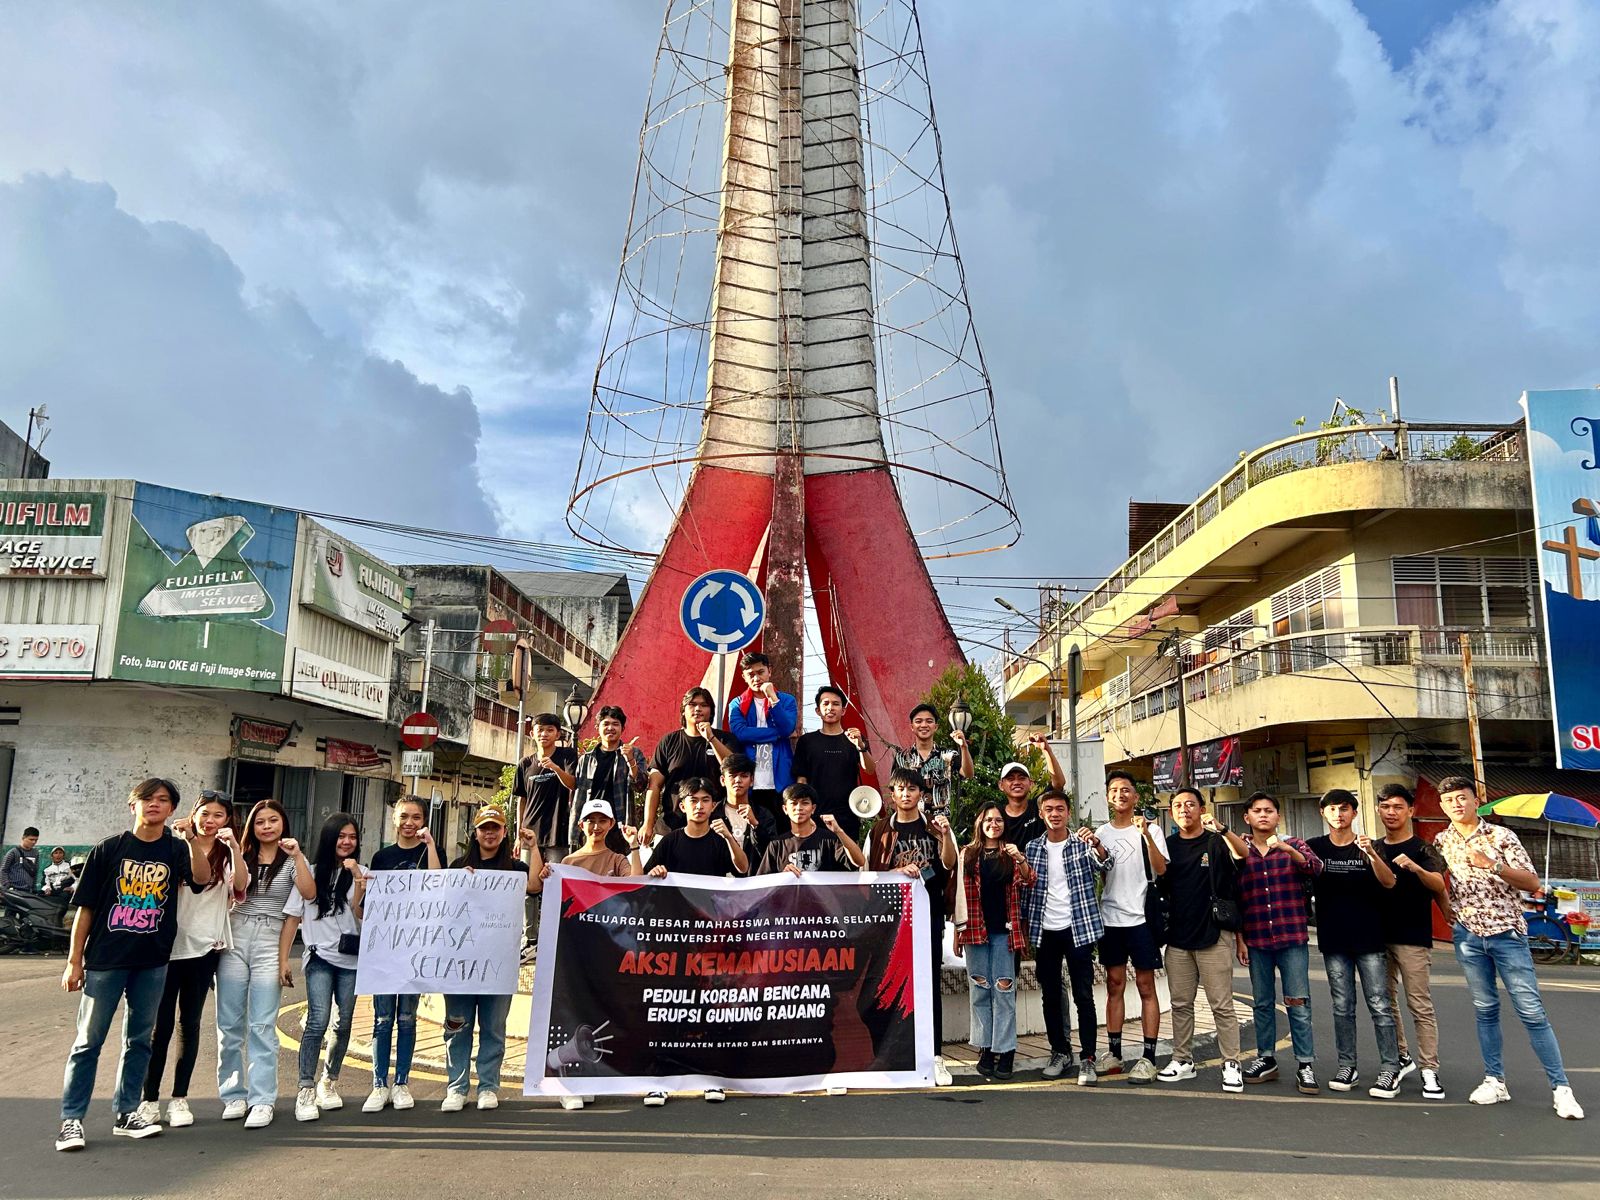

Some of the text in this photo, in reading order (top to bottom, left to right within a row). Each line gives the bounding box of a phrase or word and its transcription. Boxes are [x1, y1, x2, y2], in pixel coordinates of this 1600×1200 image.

[9, 554, 96, 570] SERVICE
[165, 570, 244, 588] FUJIFILM
[358, 563, 404, 604] FUJIFILM
[180, 587, 224, 599] IMAGE
[199, 594, 258, 607] SERVICE
[17, 637, 86, 659] FOTO
[119, 655, 277, 680] Foto, baru OKE di Fuji Image Service
[298, 661, 384, 703] NEW OLYMPIC FOTO
[123, 860, 169, 882] HARD
[119, 877, 167, 901] WORK
[368, 873, 413, 894] AKSI
[121, 894, 158, 909] IS A
[365, 900, 472, 921] MAHASISWA
[110, 906, 162, 929] MUST
[578, 912, 895, 929] KELUARGA BESAR MAHASISWA MINAHASA SELATAN
[366, 924, 475, 952] MINAHASA
[636, 929, 846, 943] DI UNIVERSITAS NEGERI MANADO
[410, 951, 503, 981] SELATAN
[618, 947, 856, 977] AKSI KEMANUSIAAN
[642, 983, 831, 1004] PEDULI KORBAN BENCANA
[647, 1003, 826, 1023] ERUPSI GUNUNG RAUANG
[771, 1037, 823, 1046] SEKITARNYA
